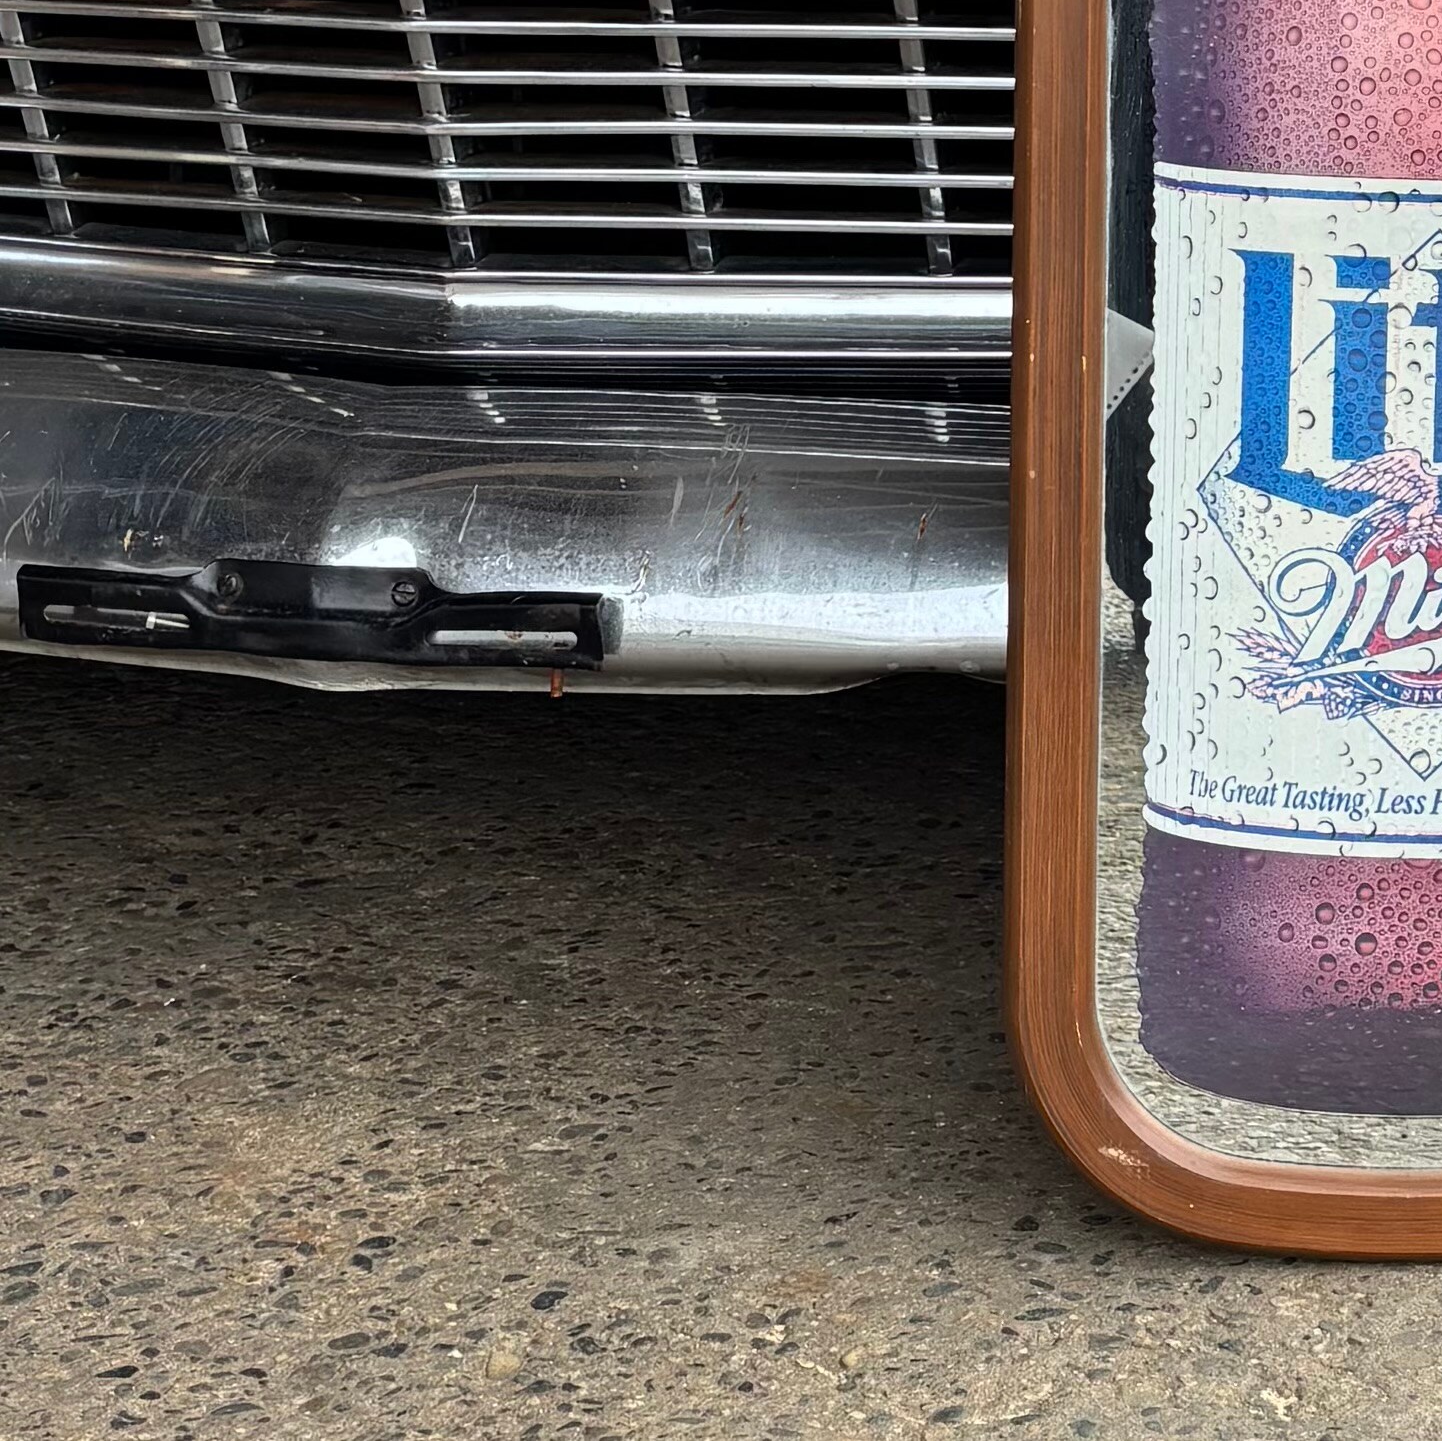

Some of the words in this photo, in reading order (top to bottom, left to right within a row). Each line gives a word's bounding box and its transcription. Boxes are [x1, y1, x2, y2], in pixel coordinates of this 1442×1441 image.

[1189, 768, 1217, 799] The
[1221, 775, 1278, 808] Great
[1282, 780, 1371, 822] Tasting,
[1374, 787, 1428, 815] Less
